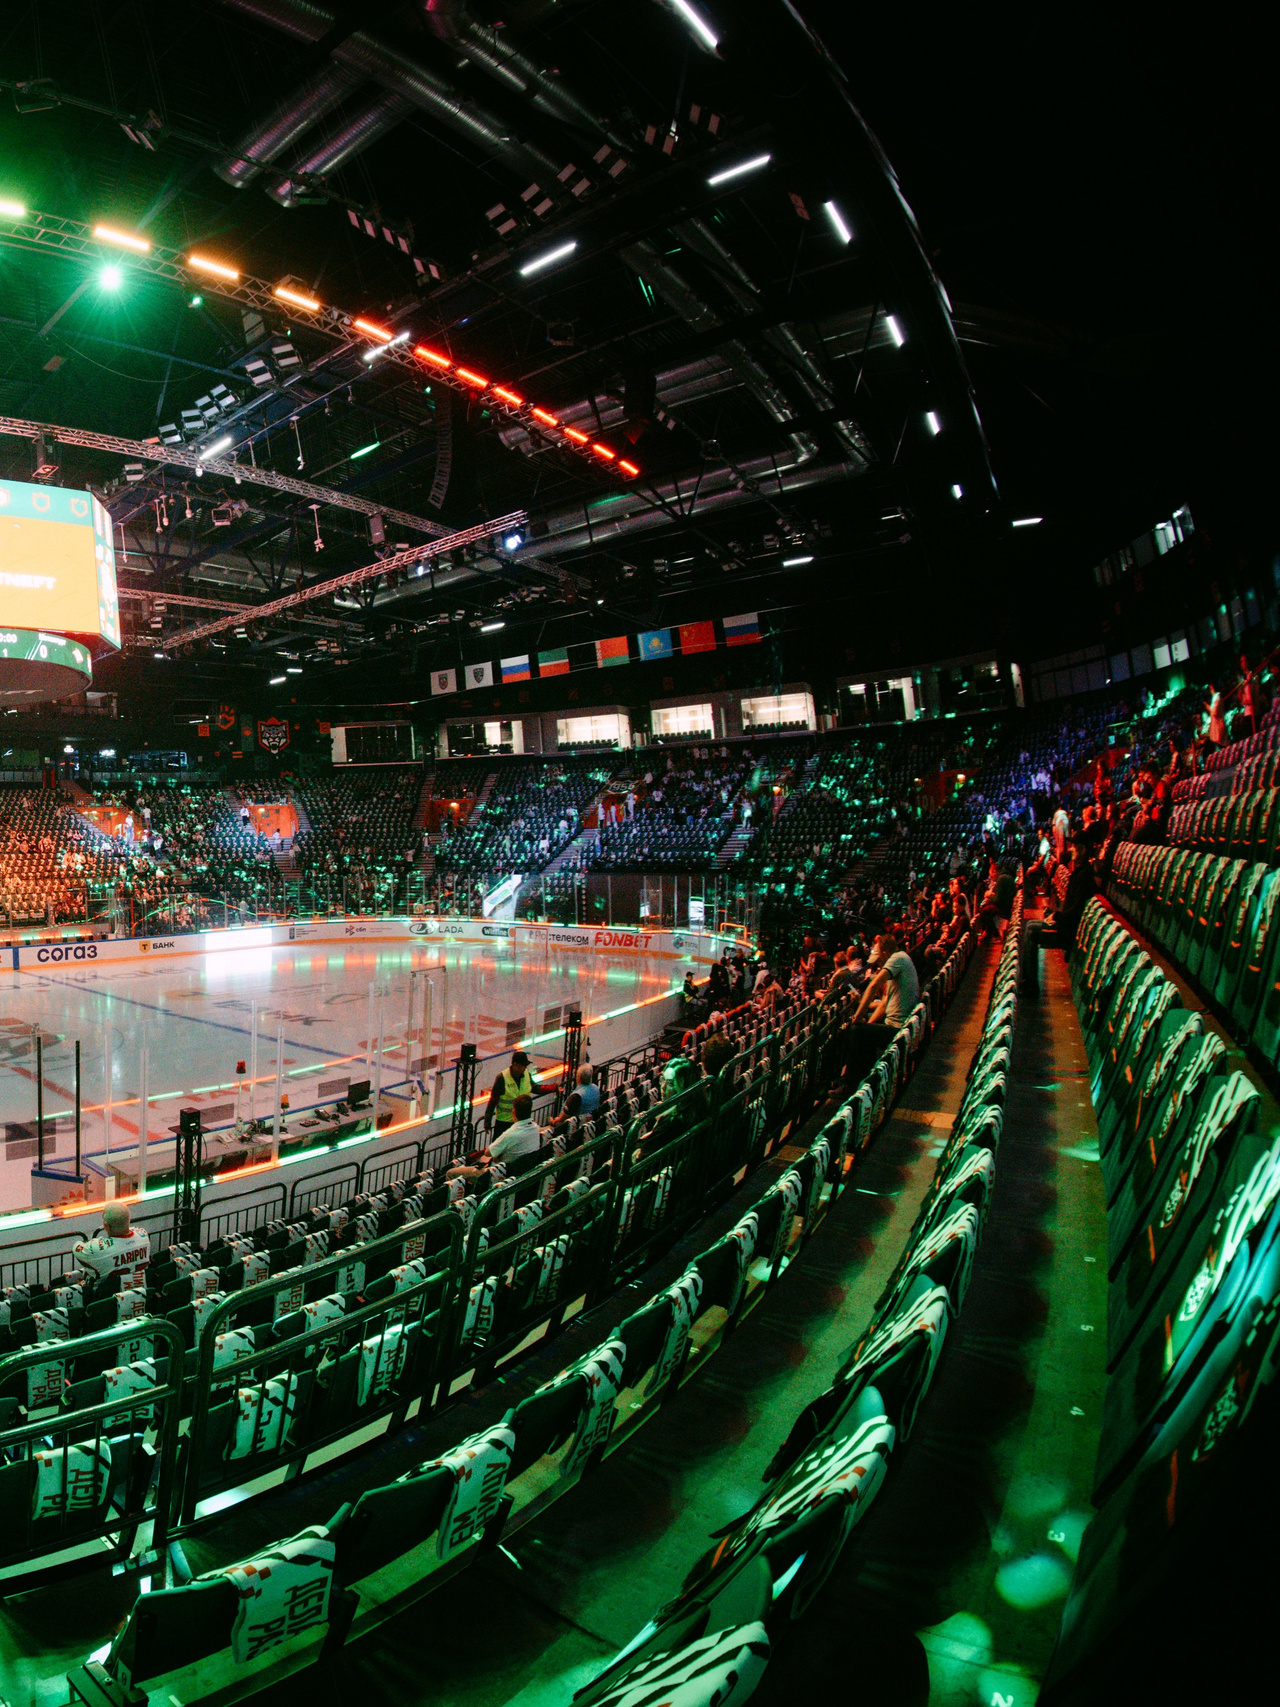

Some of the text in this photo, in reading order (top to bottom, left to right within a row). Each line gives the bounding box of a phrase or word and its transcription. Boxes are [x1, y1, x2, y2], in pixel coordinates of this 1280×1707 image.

[2, 648, 8, 658] 1
[39, 644, 48, 659] 0
[438, 926, 464, 934] LADA
[152, 941, 176, 950] БАНК
[594, 931, 653, 949] FONBET
[37, 944, 98, 964] согаз
[112, 1246, 149, 1268] ZARIPOV
[1047, 1529, 1066, 1543] 3
